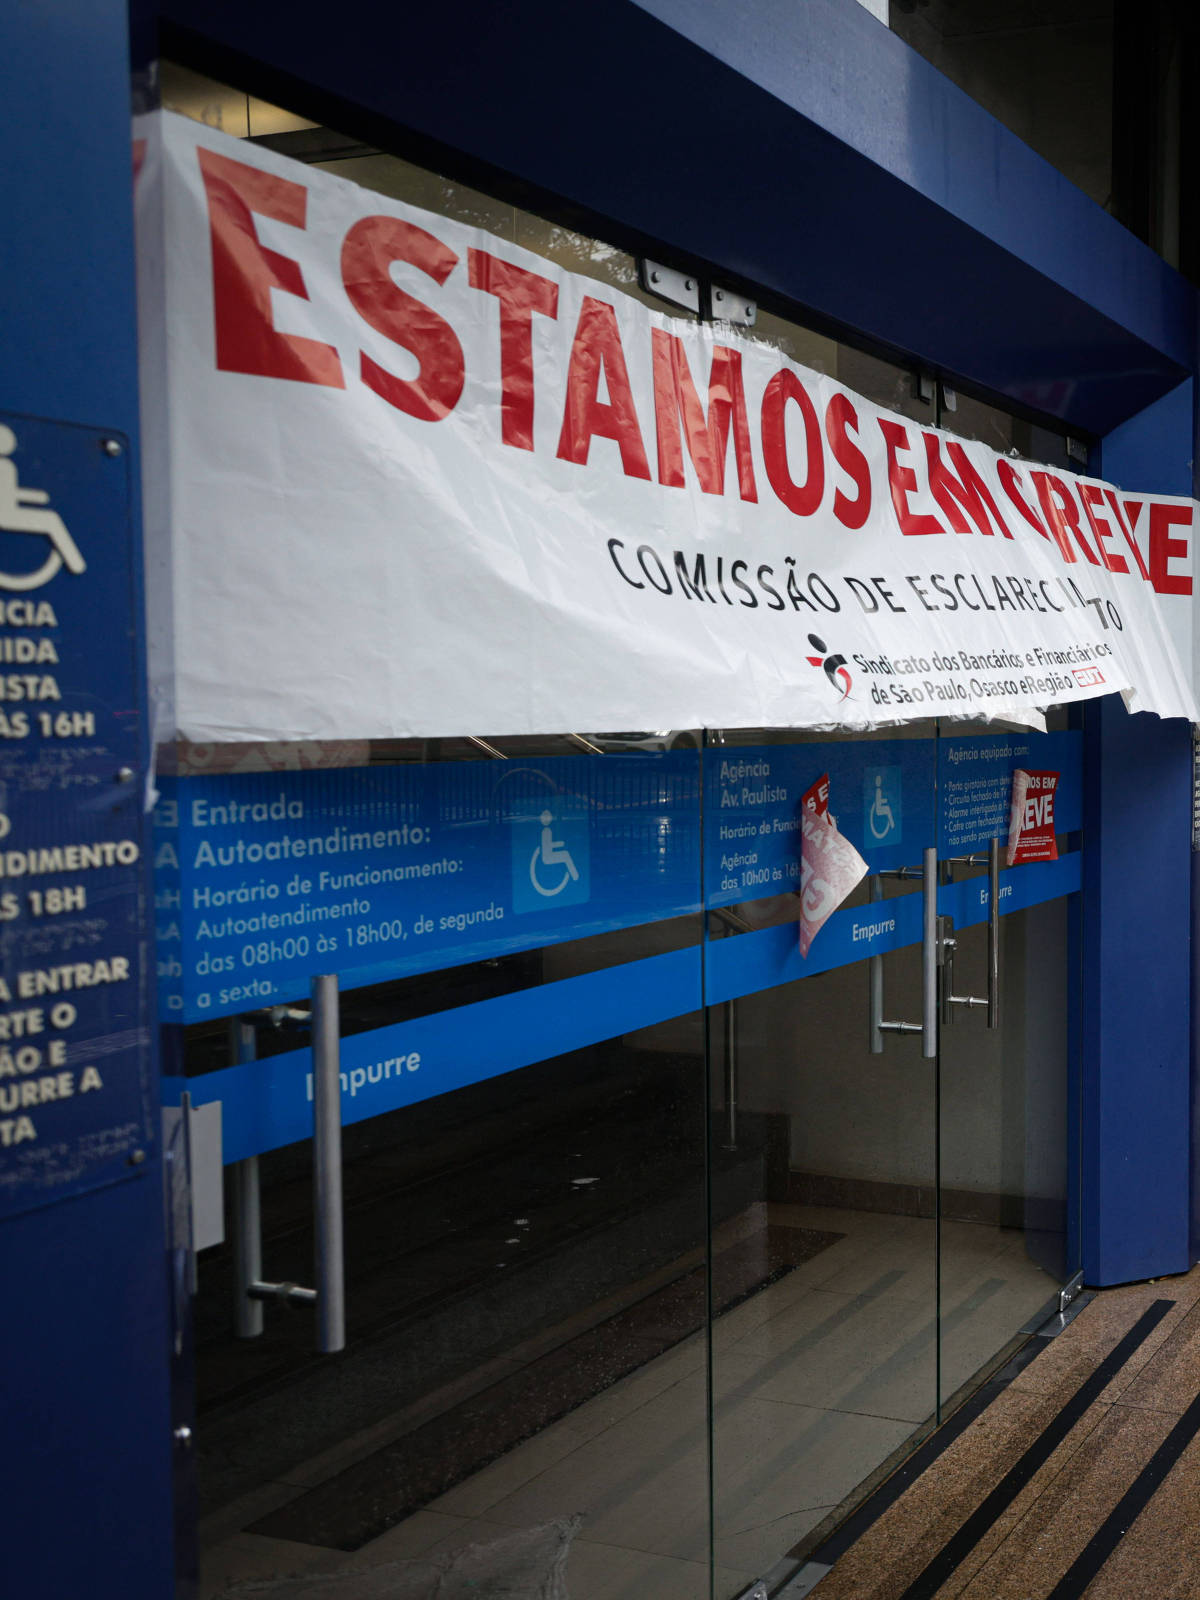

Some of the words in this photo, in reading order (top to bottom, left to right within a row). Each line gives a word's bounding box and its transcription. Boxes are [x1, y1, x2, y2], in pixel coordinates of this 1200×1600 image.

[196, 145, 871, 530] ESTAMOS
[876, 417, 1015, 540] EM
[607, 537, 841, 613] COMISSÃO
[843, 576, 906, 613] DE
[0, 600, 58, 626] CIA
[0, 638, 60, 664] IDA
[852, 653, 931, 676] Sindicato
[932, 650, 960, 672] dos
[957, 648, 1025, 672] Bancários
[1026, 652, 1035, 668] e
[1033, 642, 1113, 667] Financiários
[871, 682, 891, 705] de
[889, 683, 924, 704] São
[923, 677, 972, 702] Paulo,
[969, 678, 1018, 698] Osasco
[39, 710, 95, 738] 16H
[948, 746, 979, 765] Agência
[720, 759, 771, 784] Agência
[192, 793, 304, 827] Entrada
[742, 785, 788, 806] Paulista
[720, 817, 757, 841] Horário
[759, 818, 771, 835] de
[0, 840, 139, 878] DIMENTO
[193, 824, 432, 869] Autoatendimento:
[721, 850, 758, 872] Agência
[192, 878, 280, 910] Horário
[286, 873, 313, 897] de
[319, 857, 464, 891] Funcionamento:
[721, 874, 738, 890] das
[741, 867, 770, 887] 10h00
[772, 866, 783, 881] às
[29, 885, 86, 917] 18H
[195, 898, 371, 941] Autoatendimento
[853, 919, 896, 942] Empurre
[195, 951, 235, 976] das
[241, 935, 310, 968] 08h00
[316, 933, 338, 953] às
[346, 918, 408, 948] 18h00,
[413, 914, 435, 935] de
[439, 901, 505, 932] segunda
[18, 956, 130, 999] ENTRAR
[196, 993, 212, 1009] a
[218, 978, 279, 1006] sexta.
[51, 1002, 77, 1029] O
[49, 1039, 66, 1068] E
[80, 1065, 103, 1093] A
[306, 1051, 421, 1102] purre
